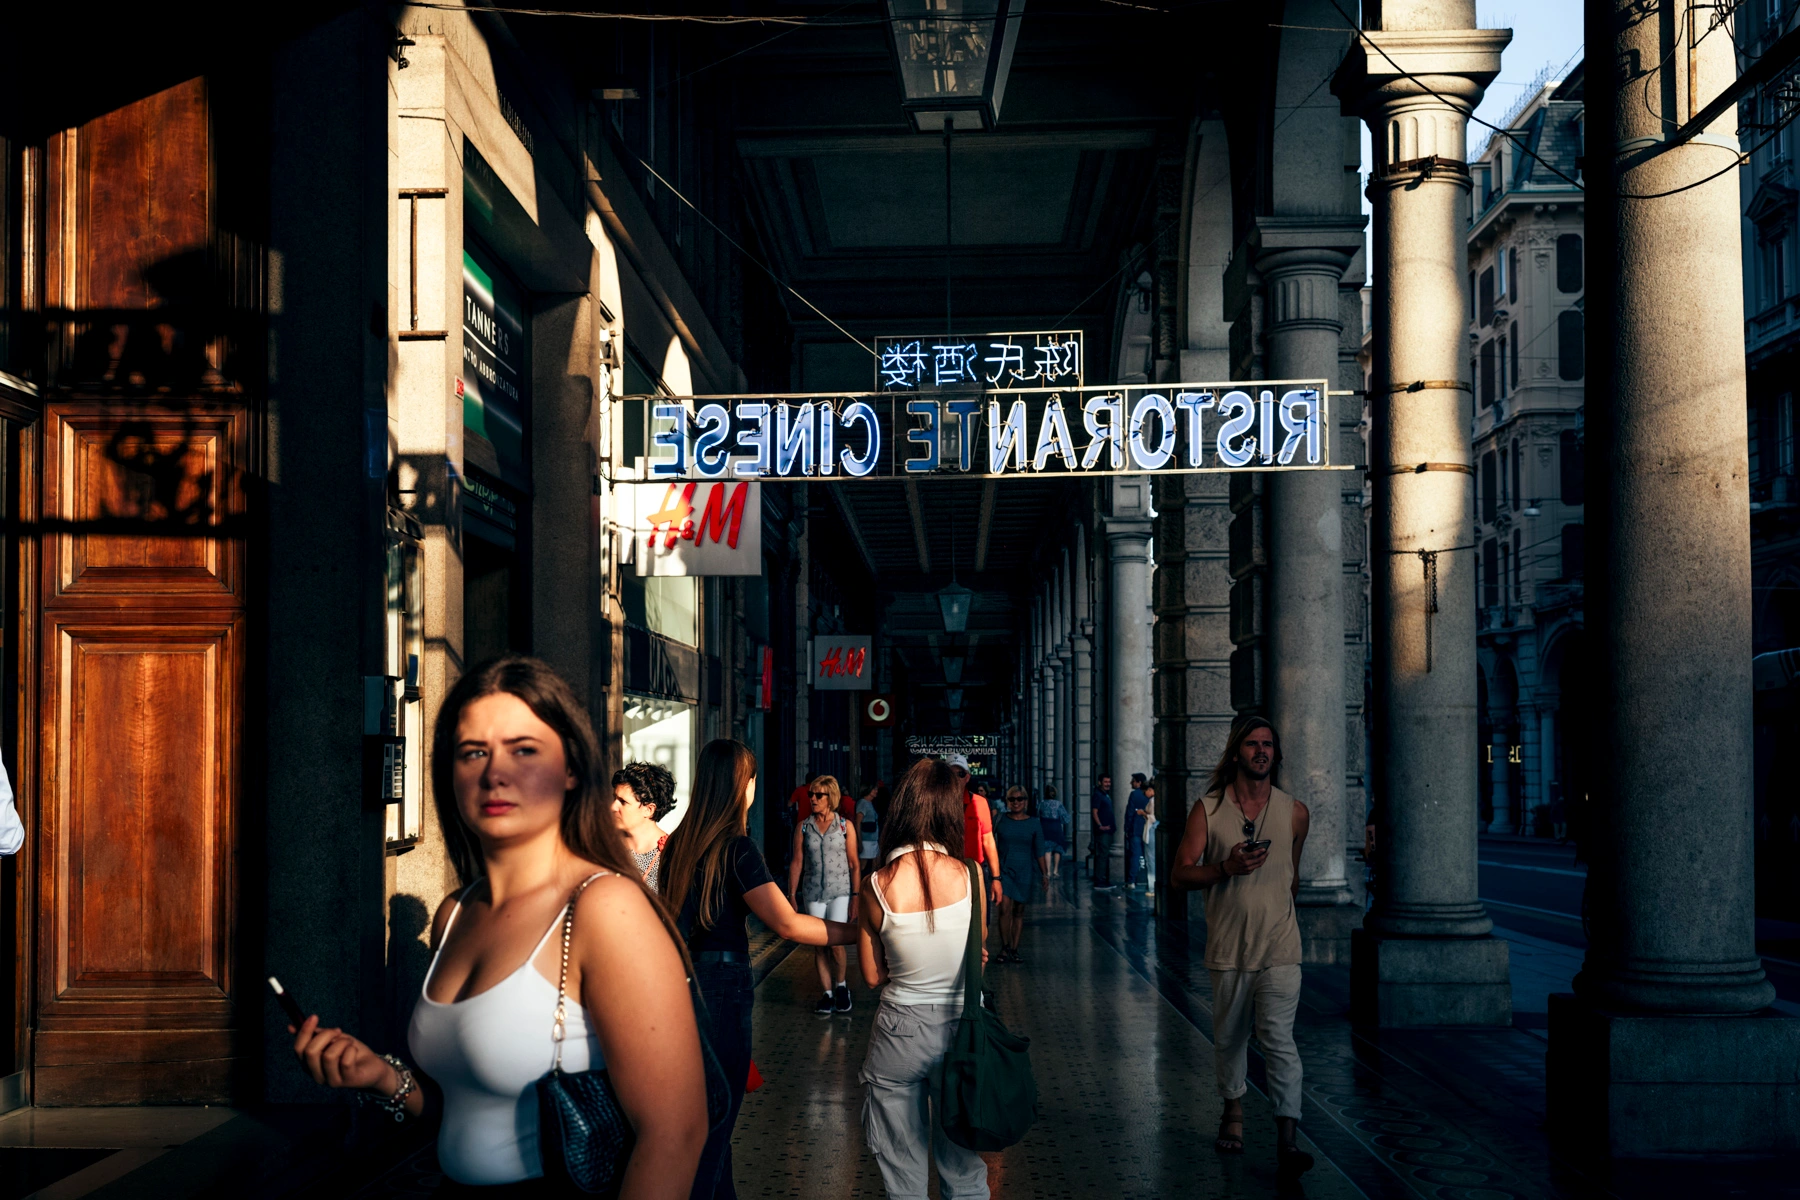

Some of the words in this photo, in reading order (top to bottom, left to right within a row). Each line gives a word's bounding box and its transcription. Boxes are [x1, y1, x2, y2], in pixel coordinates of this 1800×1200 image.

[466, 295, 509, 356] TANNERS
[479, 360, 519, 402] ABBRONZATURA
[646, 481, 749, 550] H&M
[819, 646, 867, 678] H&M
